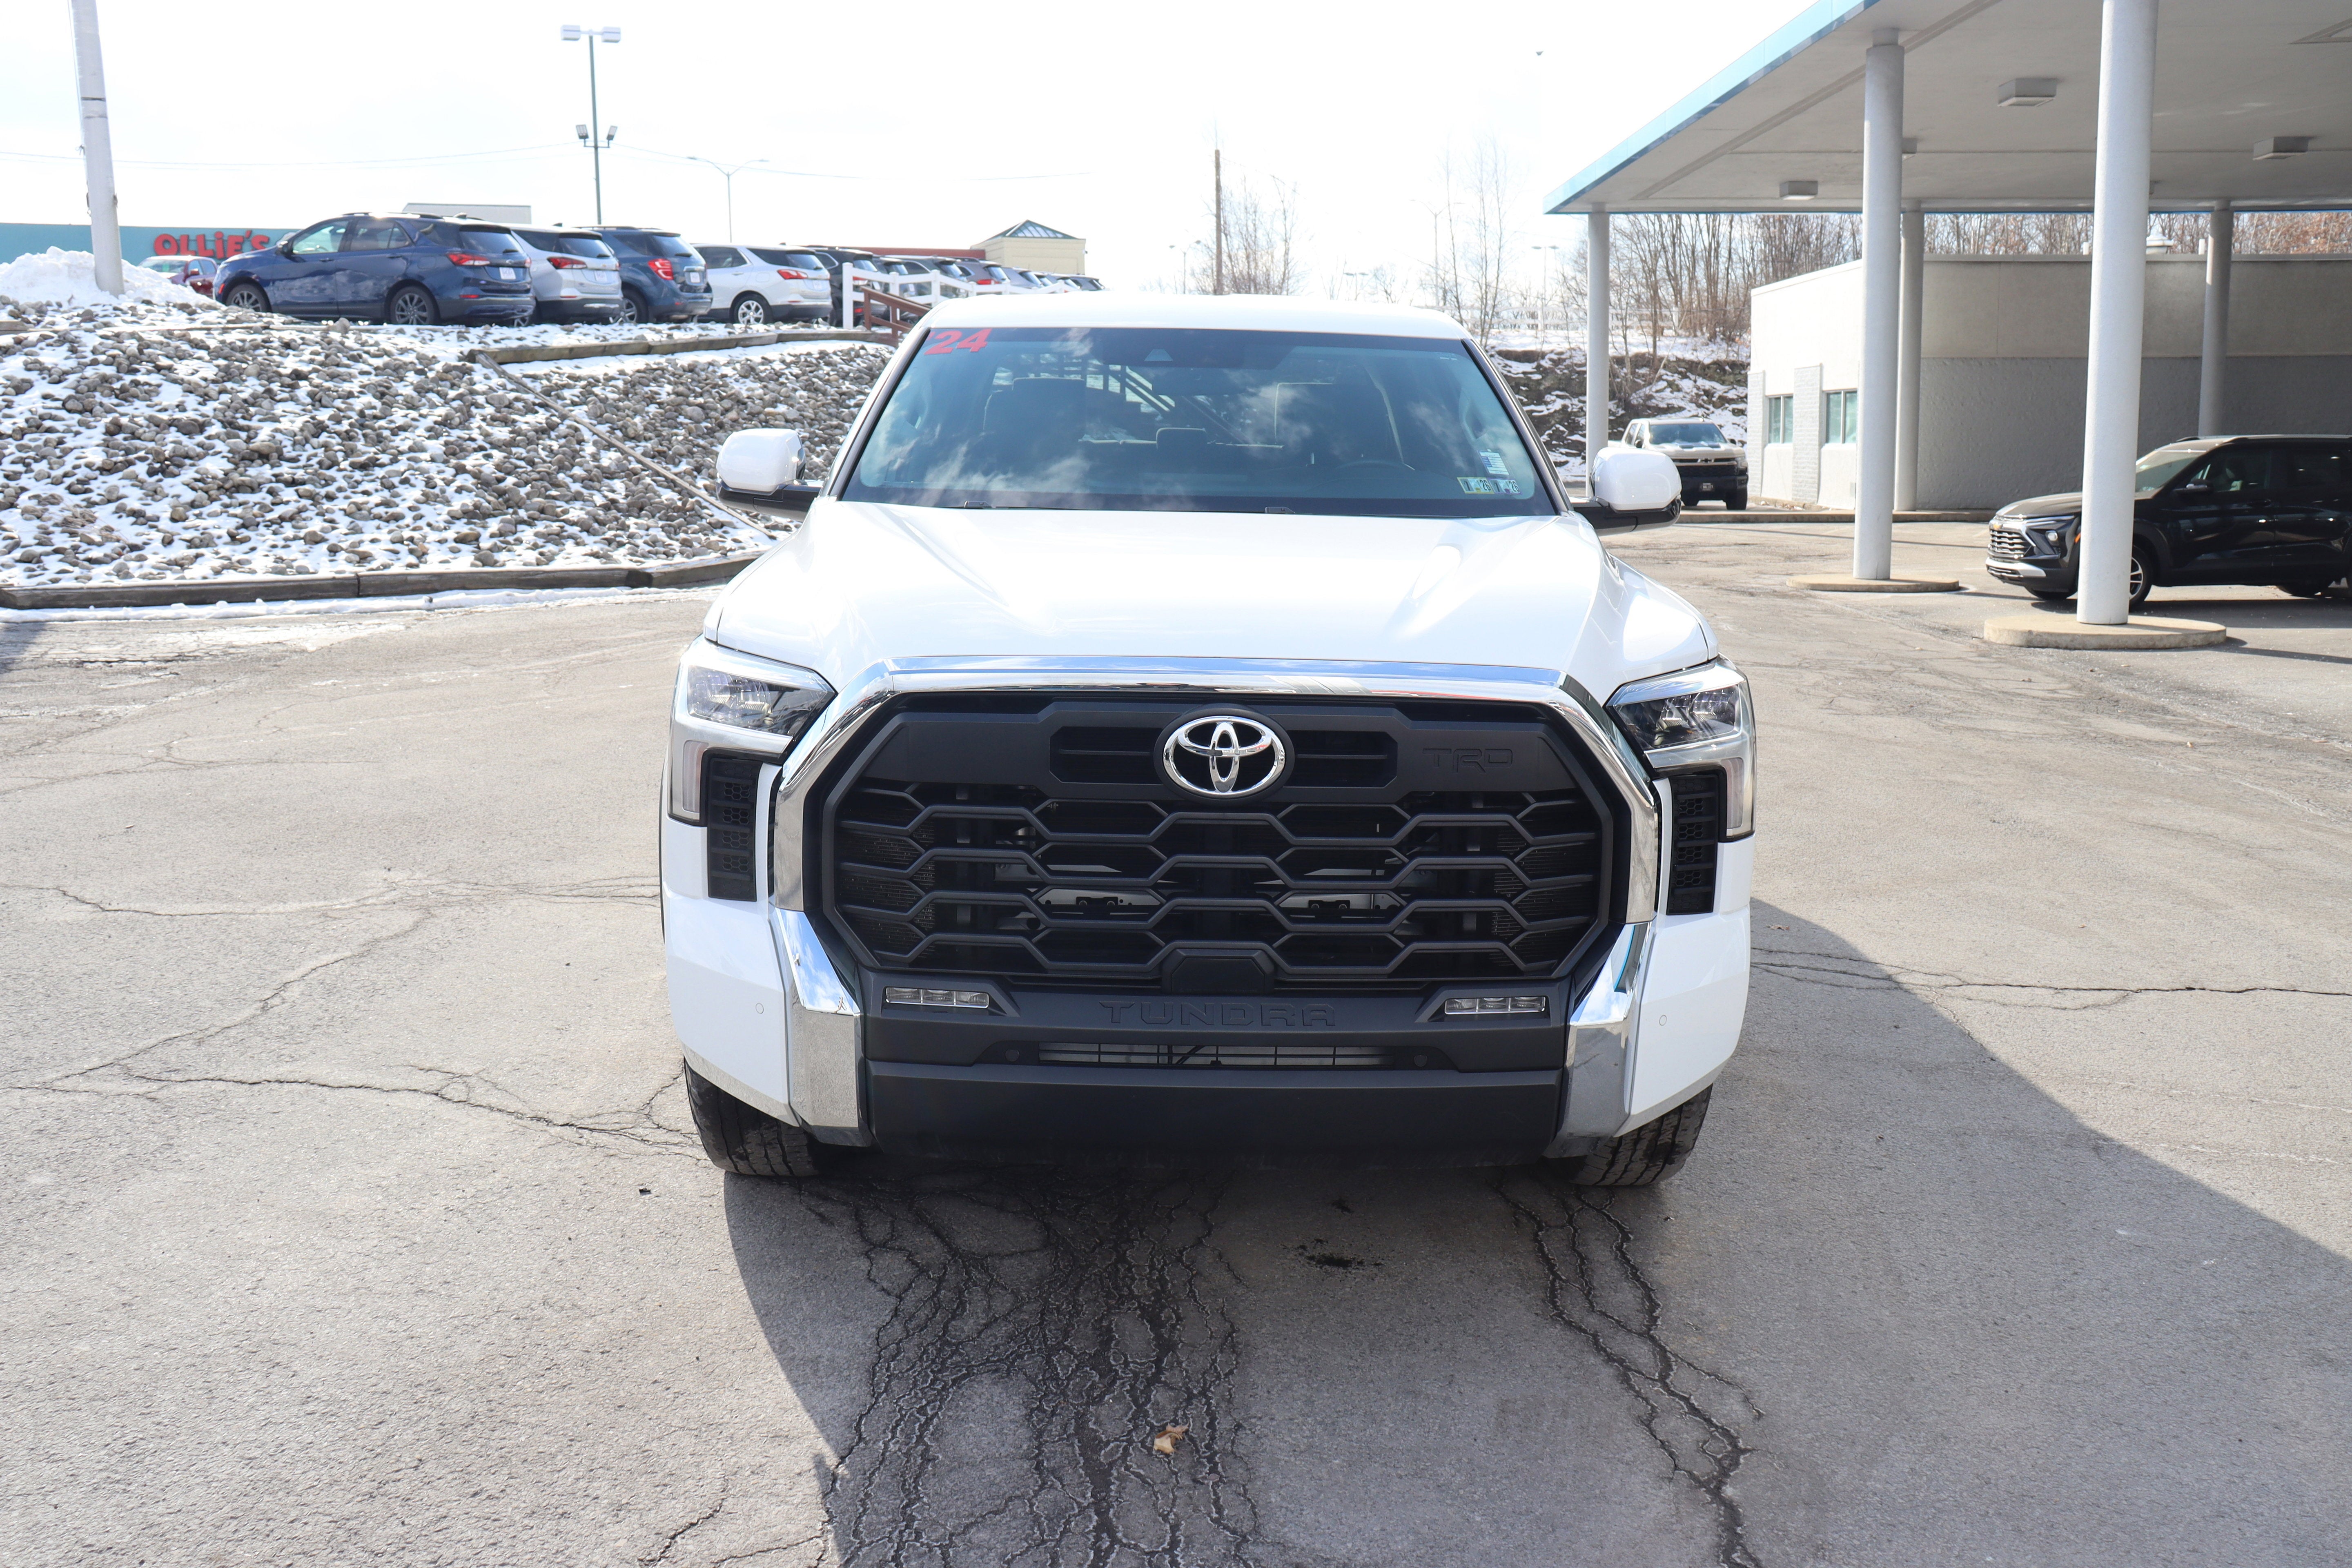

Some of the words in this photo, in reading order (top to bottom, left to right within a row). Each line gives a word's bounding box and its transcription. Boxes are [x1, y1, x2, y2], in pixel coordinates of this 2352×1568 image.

[1480, 479, 1491, 491] 26
[1508, 481, 1520, 492] 26
[1422, 748, 1513, 774] TRD
[1098, 1000, 1336, 1027] TUNDRA
